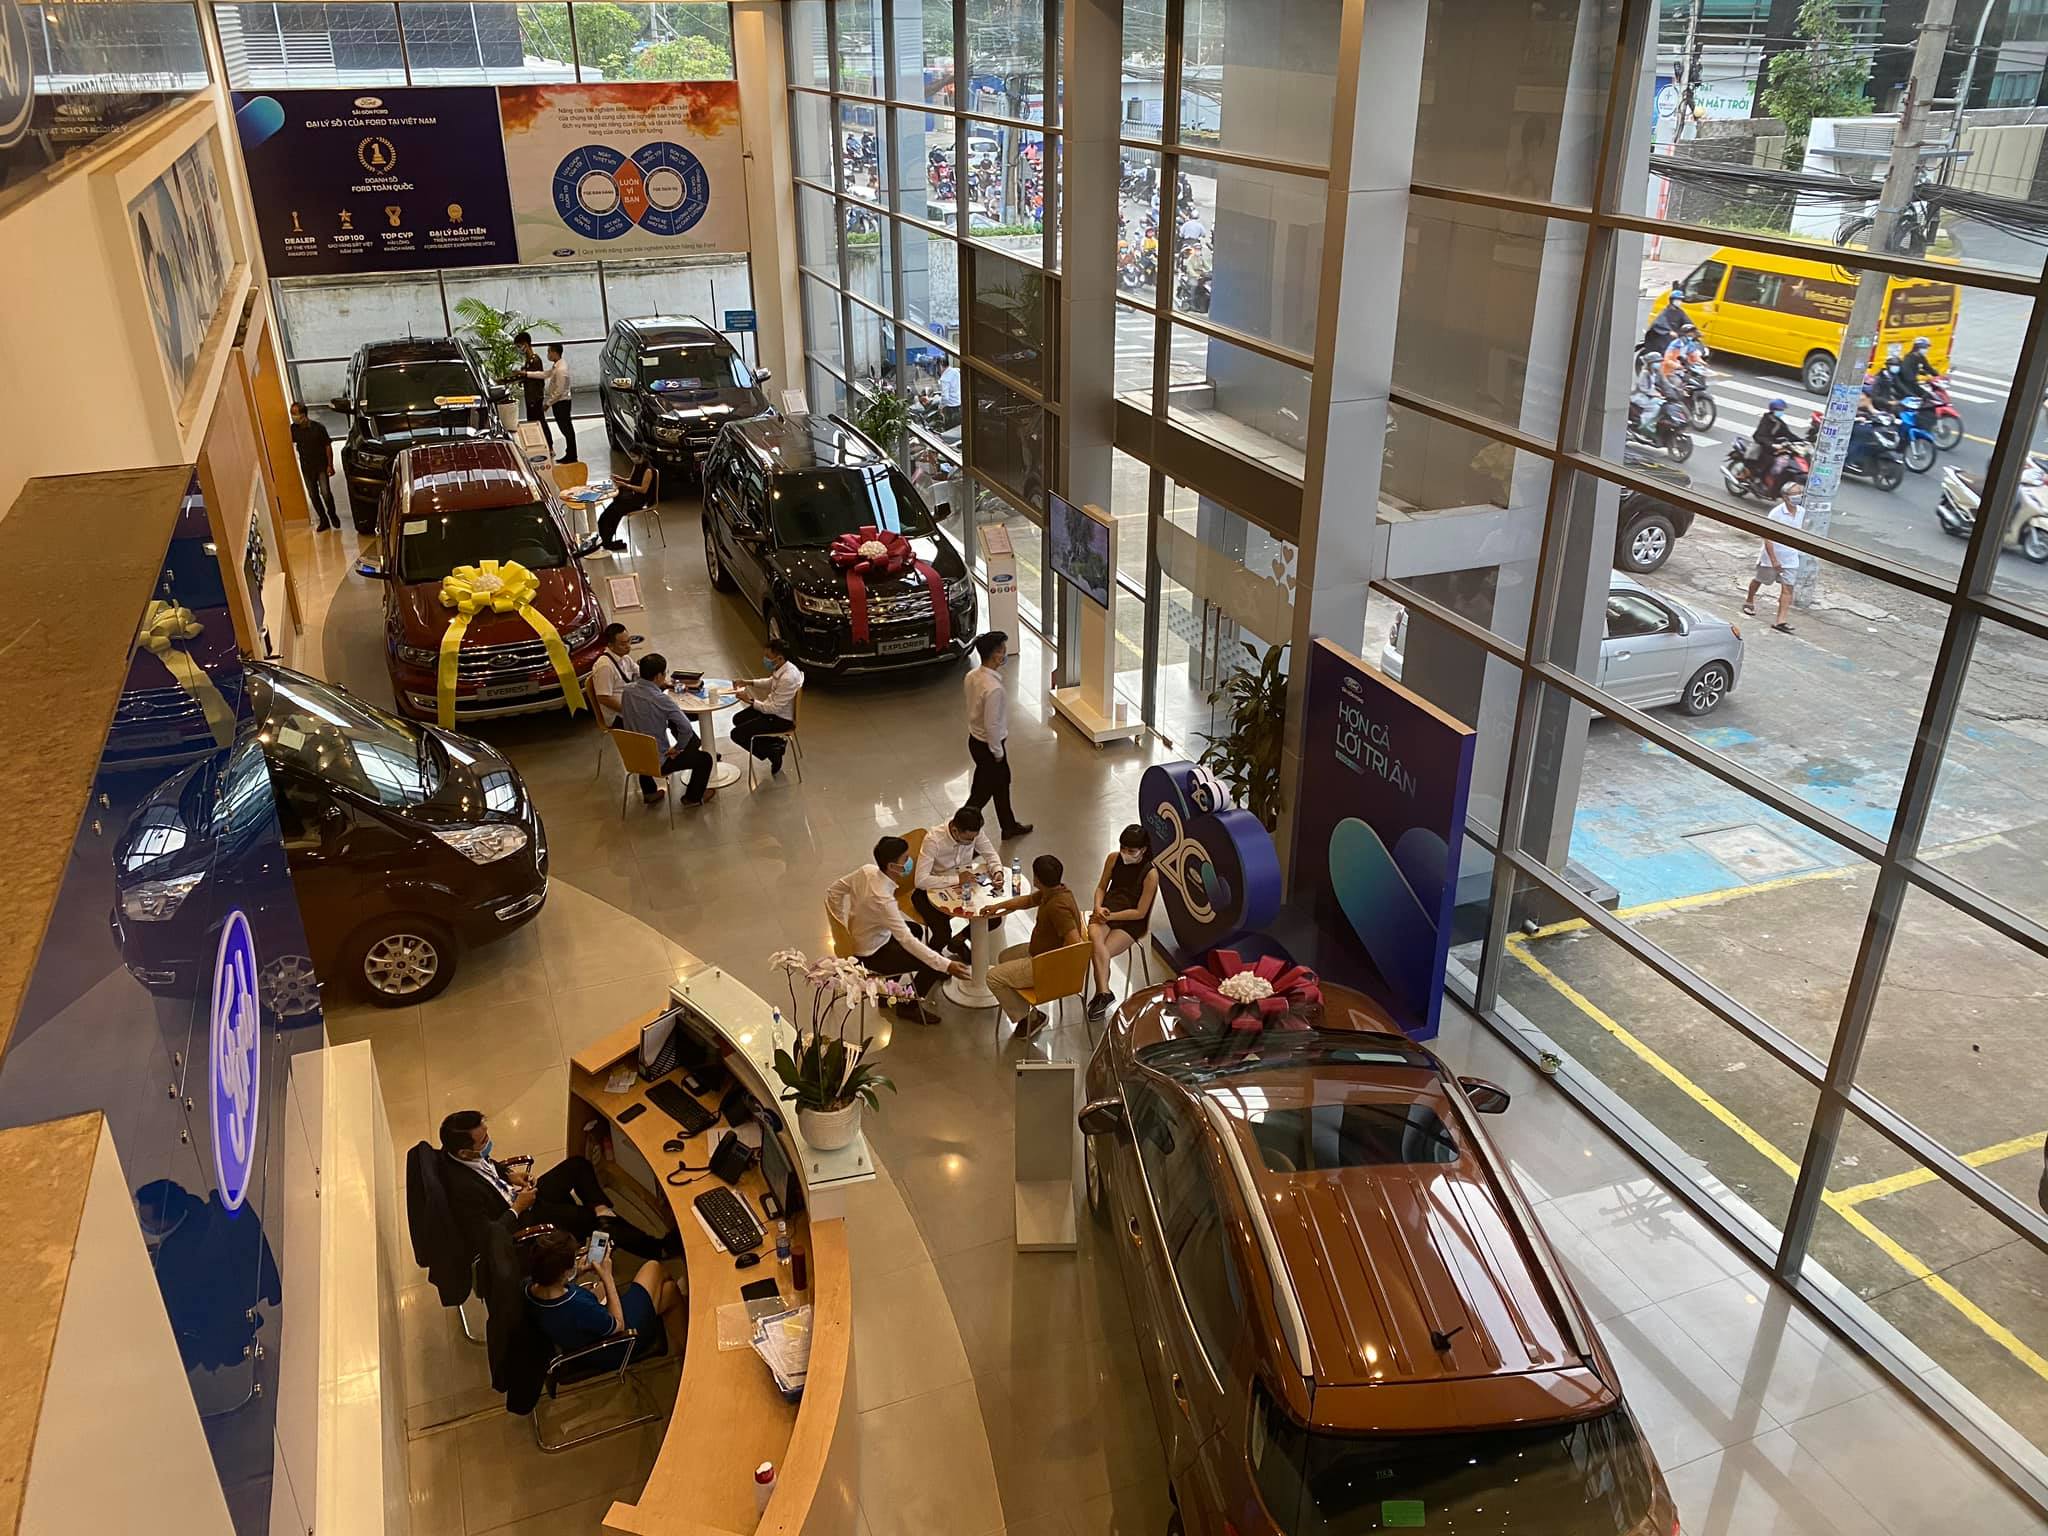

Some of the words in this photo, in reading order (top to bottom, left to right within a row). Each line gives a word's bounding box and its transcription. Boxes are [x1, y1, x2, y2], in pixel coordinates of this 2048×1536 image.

[320, 119, 330, 127] LÝ
[348, 118, 364, 126] CỦA
[400, 116, 418, 125] VIỆT
[393, 182, 414, 192] QUỐC
[620, 178, 640, 186] LUÔN
[882, 639, 924, 651] EXPLORER
[486, 686, 529, 697] EVEREST
[1370, 724, 1390, 750] CẢ
[1336, 724, 1362, 758] LỜI
[1364, 743, 1388, 778] TRI
[1389, 759, 1416, 798] ÂN
